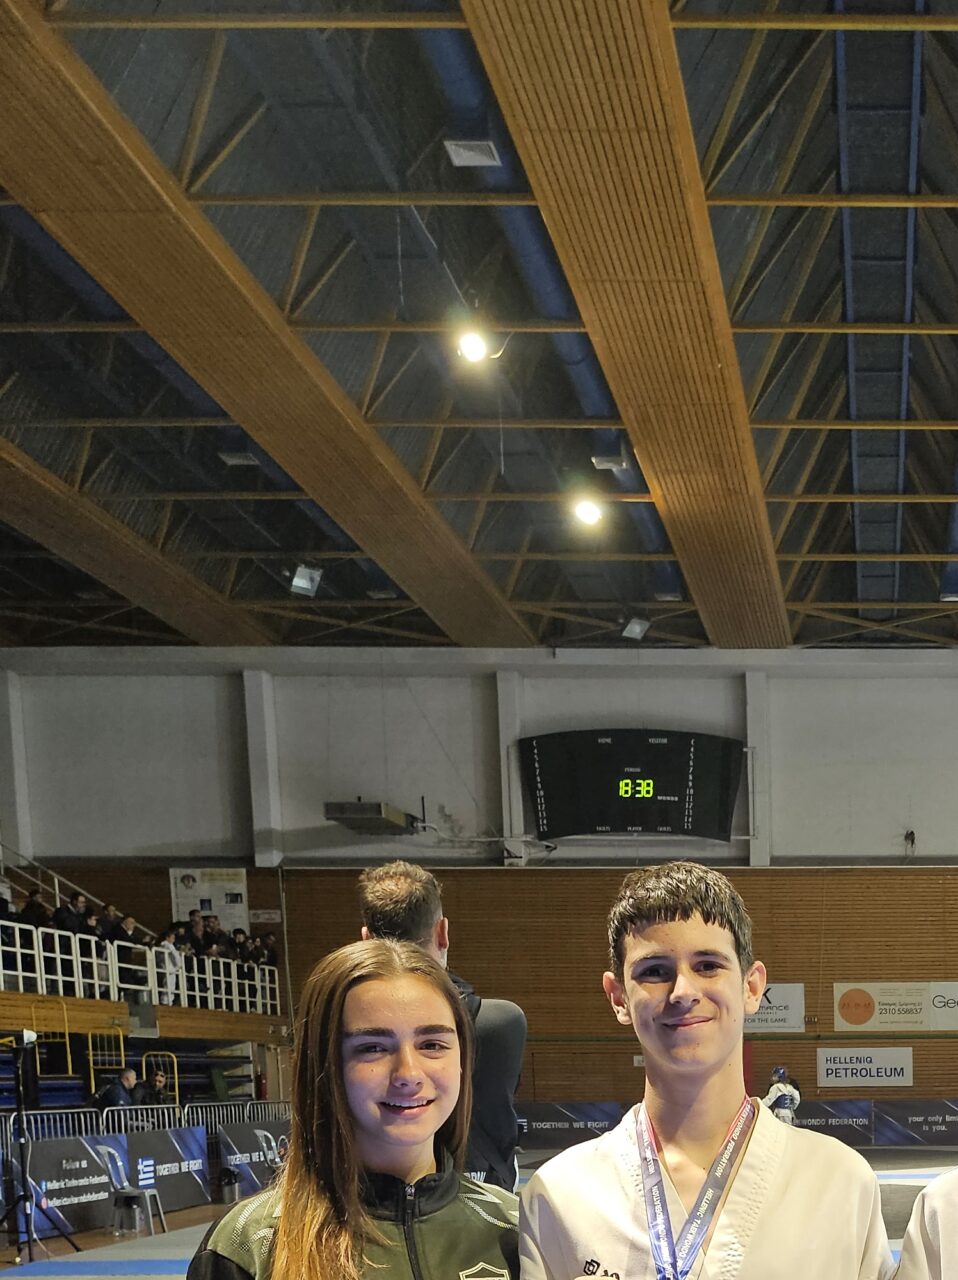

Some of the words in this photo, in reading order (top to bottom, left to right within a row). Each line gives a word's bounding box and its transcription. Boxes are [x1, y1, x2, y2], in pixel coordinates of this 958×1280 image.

[619, 779, 653, 797] 18:38
[825, 1067, 905, 1079] PETROLEUM
[532, 1121, 569, 1129] TOGETHER
[573, 1121, 585, 1129] WE
[588, 1121, 610, 1129] FIGHT
[828, 1118, 868, 1126] FEDERATION
[928, 1115, 942, 1123] only
[227, 1153, 250, 1165] TOGETHER
[713, 1138, 736, 1177] FEDERATION
[156, 1163, 179, 1176] TOGETHER
[181, 1161, 189, 1172] WE
[190, 1159, 202, 1171] FIGHT
[695, 1187, 715, 1218] HELLENIC
[677, 1217, 701, 1258] TAEKWONDO
